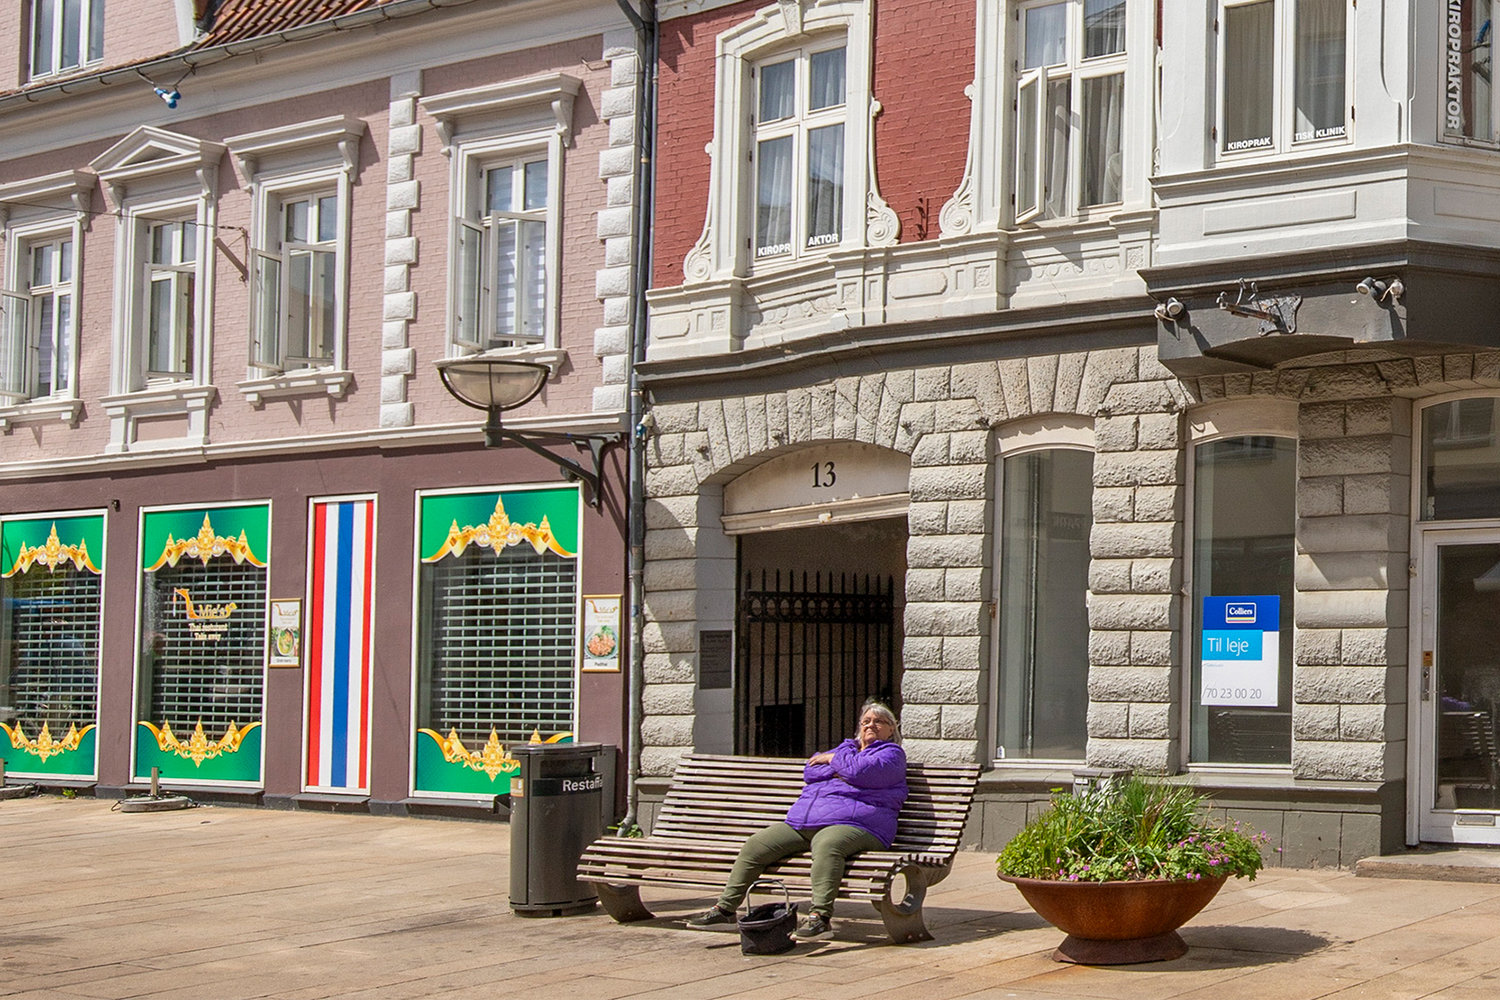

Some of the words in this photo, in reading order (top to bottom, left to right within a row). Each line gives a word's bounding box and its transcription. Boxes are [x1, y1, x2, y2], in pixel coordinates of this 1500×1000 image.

[1227, 136, 1271, 151] KIROPRAK
[1295, 129, 1314, 141] TISK
[1316, 126, 1345, 138] KLINIK
[758, 243, 791, 256] KIROPR
[808, 233, 839, 246] AKTOR
[811, 461, 836, 488] 13
[1207, 637, 1222, 652] Til
[1226, 637, 1249, 656] leje
[1220, 688, 1232, 699] 23
[1234, 688, 1248, 699] 00
[1249, 688, 1262, 699] 20
